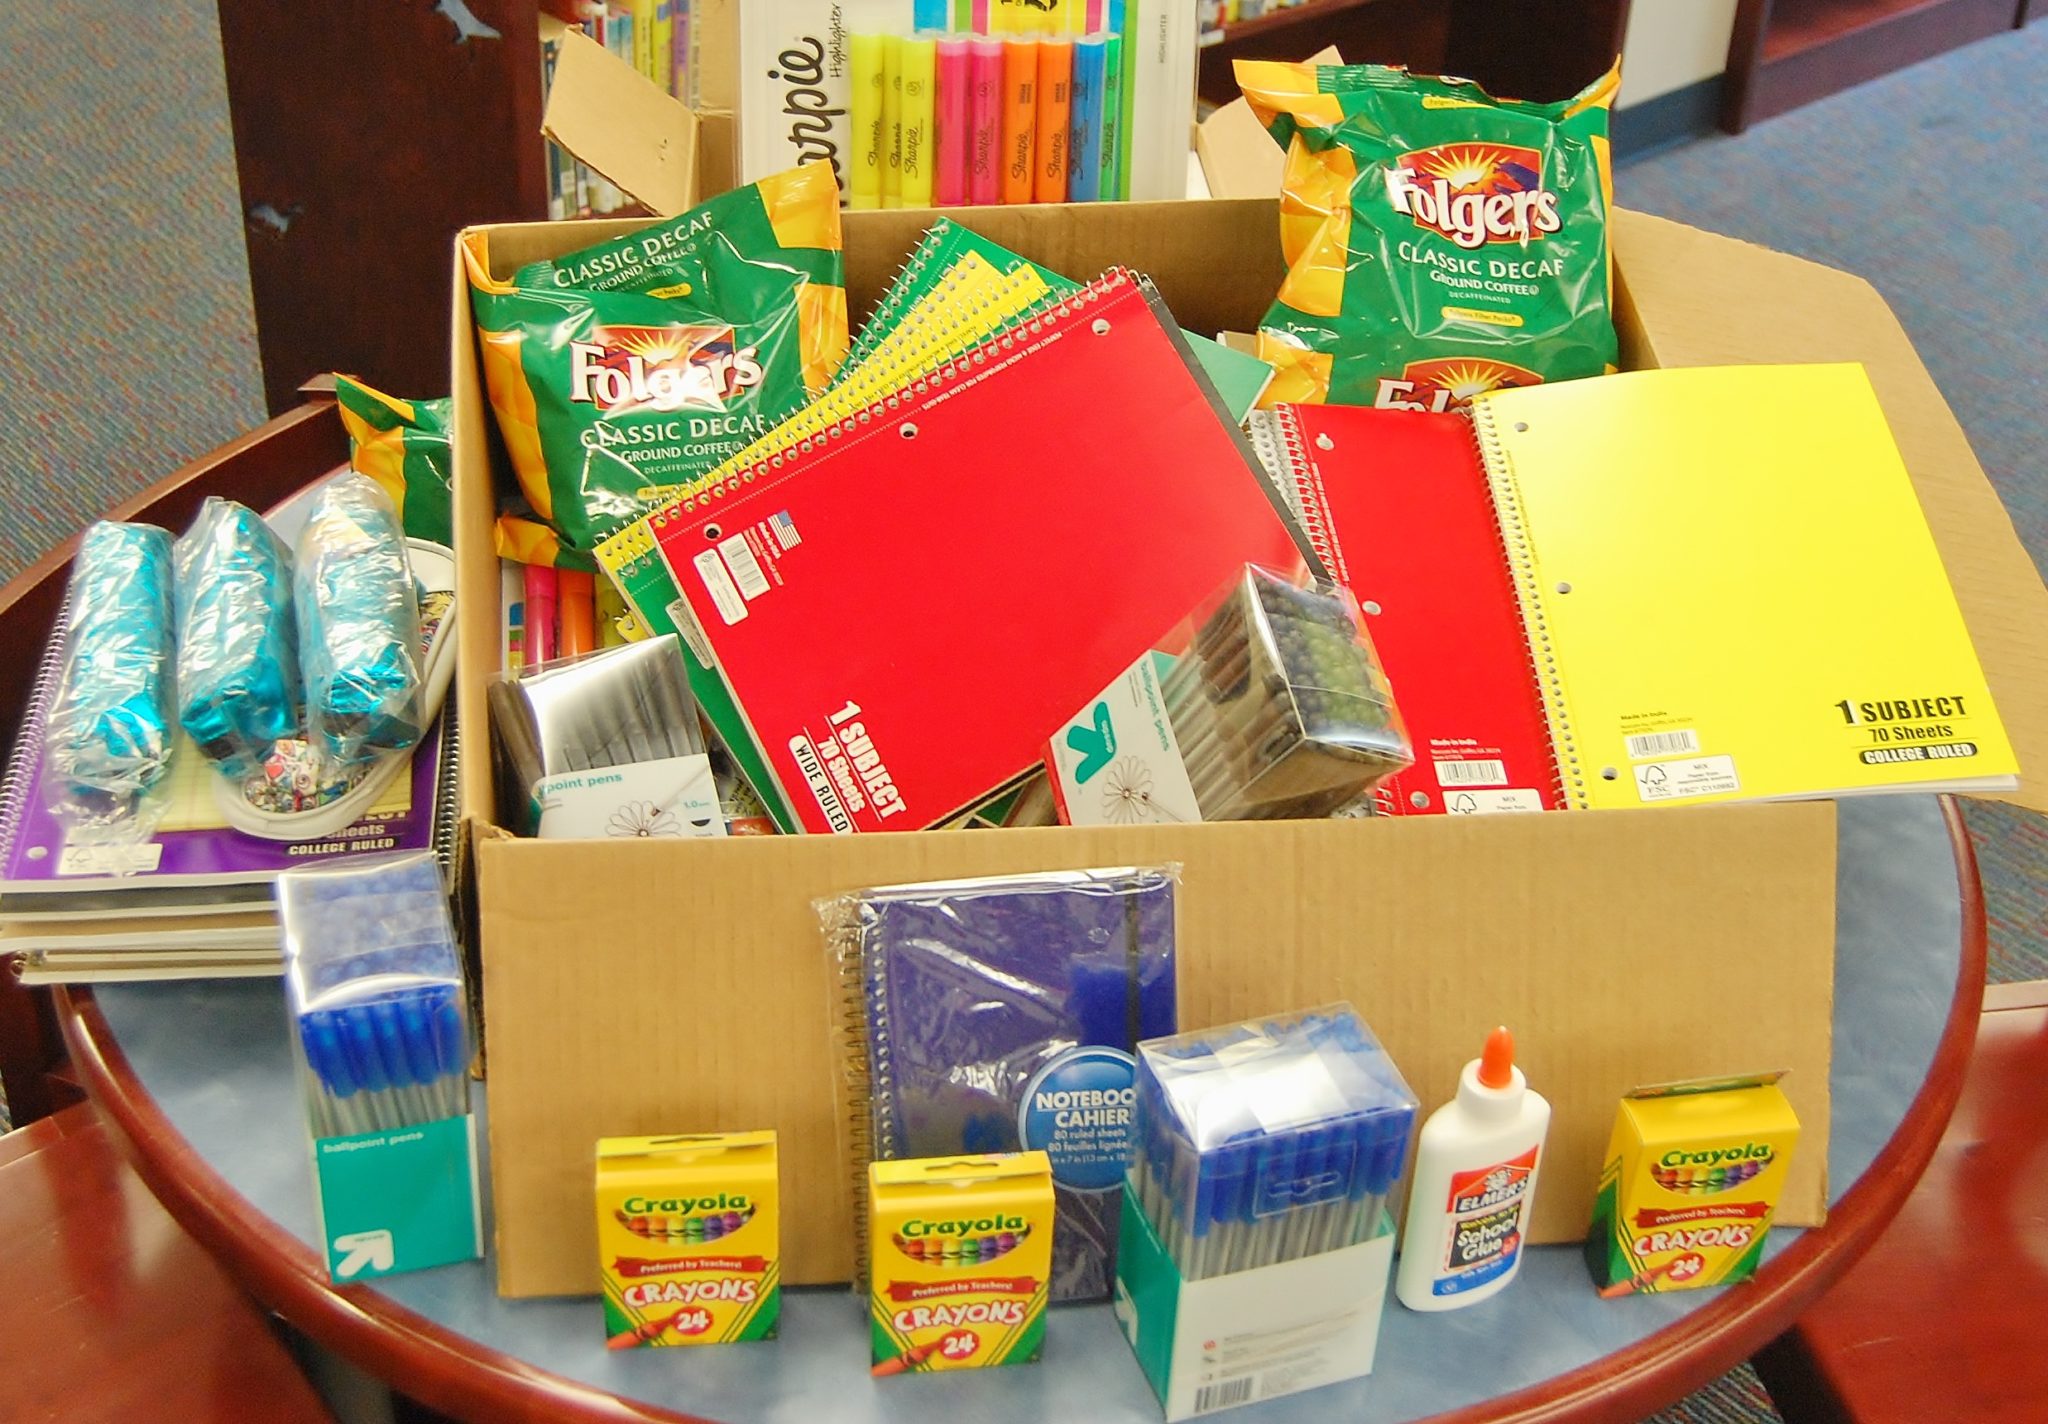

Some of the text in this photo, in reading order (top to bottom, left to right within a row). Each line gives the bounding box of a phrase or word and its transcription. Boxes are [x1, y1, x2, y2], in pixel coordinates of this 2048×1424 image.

[829, 3, 847, 78] Highlighter
[904, 126, 919, 180] Sharpie
[1012, 130, 1029, 184] Sharpie
[1048, 130, 1065, 182] Sharpie
[1384, 164, 1562, 249] Folgers
[553, 211, 714, 290] CLASSIC DECAF
[1398, 241, 1564, 280] CLASSIC DECAF
[589, 264, 644, 293] GROUND
[1429, 270, 1530, 296] GROUND COFFEE
[569, 341, 765, 412] Folgers
[579, 414, 766, 450] CLASSIC DECAF
[619, 441, 732, 465] GROUND COFFEE
[1833, 695, 1967, 725] 1 SUBJECT
[1868, 723, 1954, 743] 70 Sheets
[828, 700, 908, 819] 1 SUBJECT
[1862, 743, 1974, 765] COLLEGE RULED
[587, 772, 624, 787] pens
[816, 734, 867, 814] 70 Sheets
[795, 743, 850, 833] WIDE RULED
[288, 838, 395, 856] COLLEGE RULED
[1036, 1088, 1137, 1110] NOTEBOO
[1055, 1108, 1131, 1128] CAHIER
[1054, 1126, 1127, 1141] 80 ruled sheets
[1661, 1142, 1769, 1166] Crayola
[623, 1192, 748, 1215] Crayola
[1655, 1210, 1696, 1224] Preferred
[1696, 1208, 1708, 1219] by
[902, 1213, 1024, 1237] Crayola
[1456, 1210, 1518, 1247] School
[1462, 1237, 1503, 1261] Glue
[1634, 1225, 1754, 1256] CRAYONS
[640, 1261, 685, 1273] Preferred
[685, 1261, 698, 1271] by
[1669, 1255, 1701, 1276] 24
[623, 1278, 758, 1307] CRAYONS
[911, 1283, 957, 1298] Preferred
[956, 1283, 970, 1294] by
[676, 1309, 709, 1331] 24
[894, 1301, 1026, 1332] CRAYONS
[942, 1333, 976, 1355] 24
